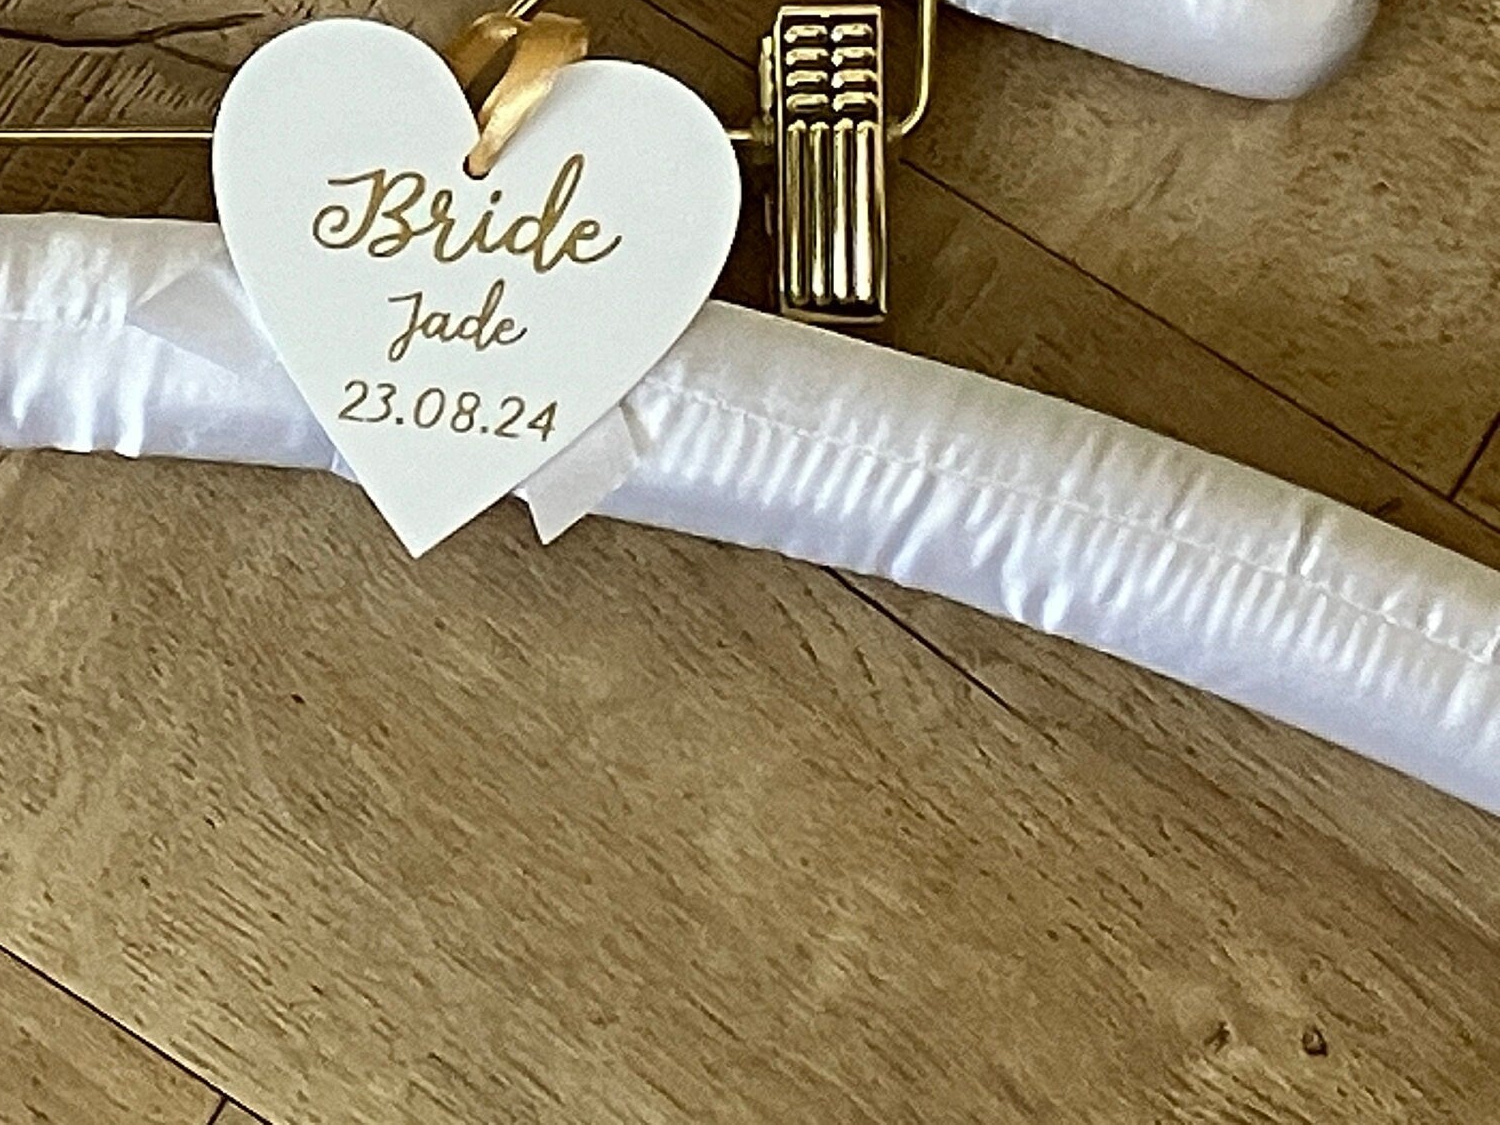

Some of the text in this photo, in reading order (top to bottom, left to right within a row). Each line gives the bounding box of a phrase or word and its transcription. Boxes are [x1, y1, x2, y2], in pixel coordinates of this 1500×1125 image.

[312, 153, 623, 274] Bride
[387, 278, 528, 363] Jade
[337, 380, 558, 442] 23.08.24
